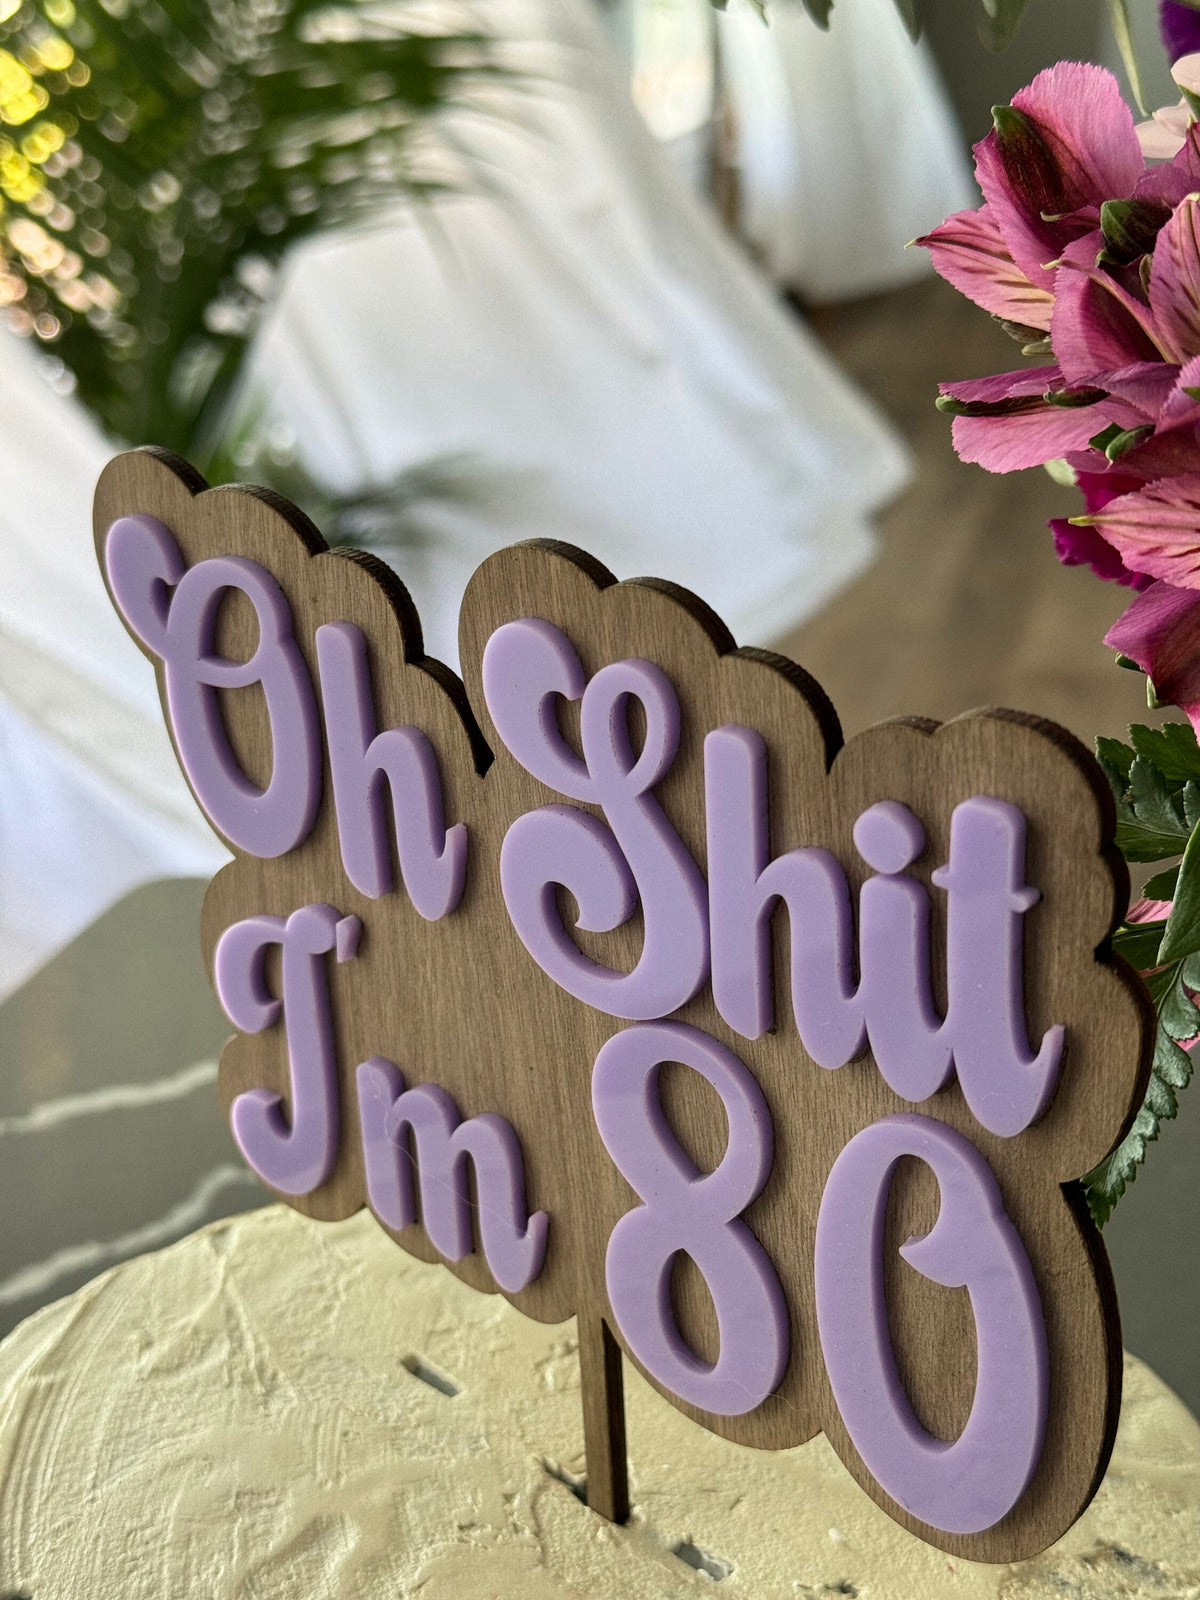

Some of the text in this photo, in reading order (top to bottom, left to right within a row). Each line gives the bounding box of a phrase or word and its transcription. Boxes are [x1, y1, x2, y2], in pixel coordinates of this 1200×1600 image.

[105, 515, 1065, 1138] Oh Shit
[214, 903, 1050, 1535] I'm 80
